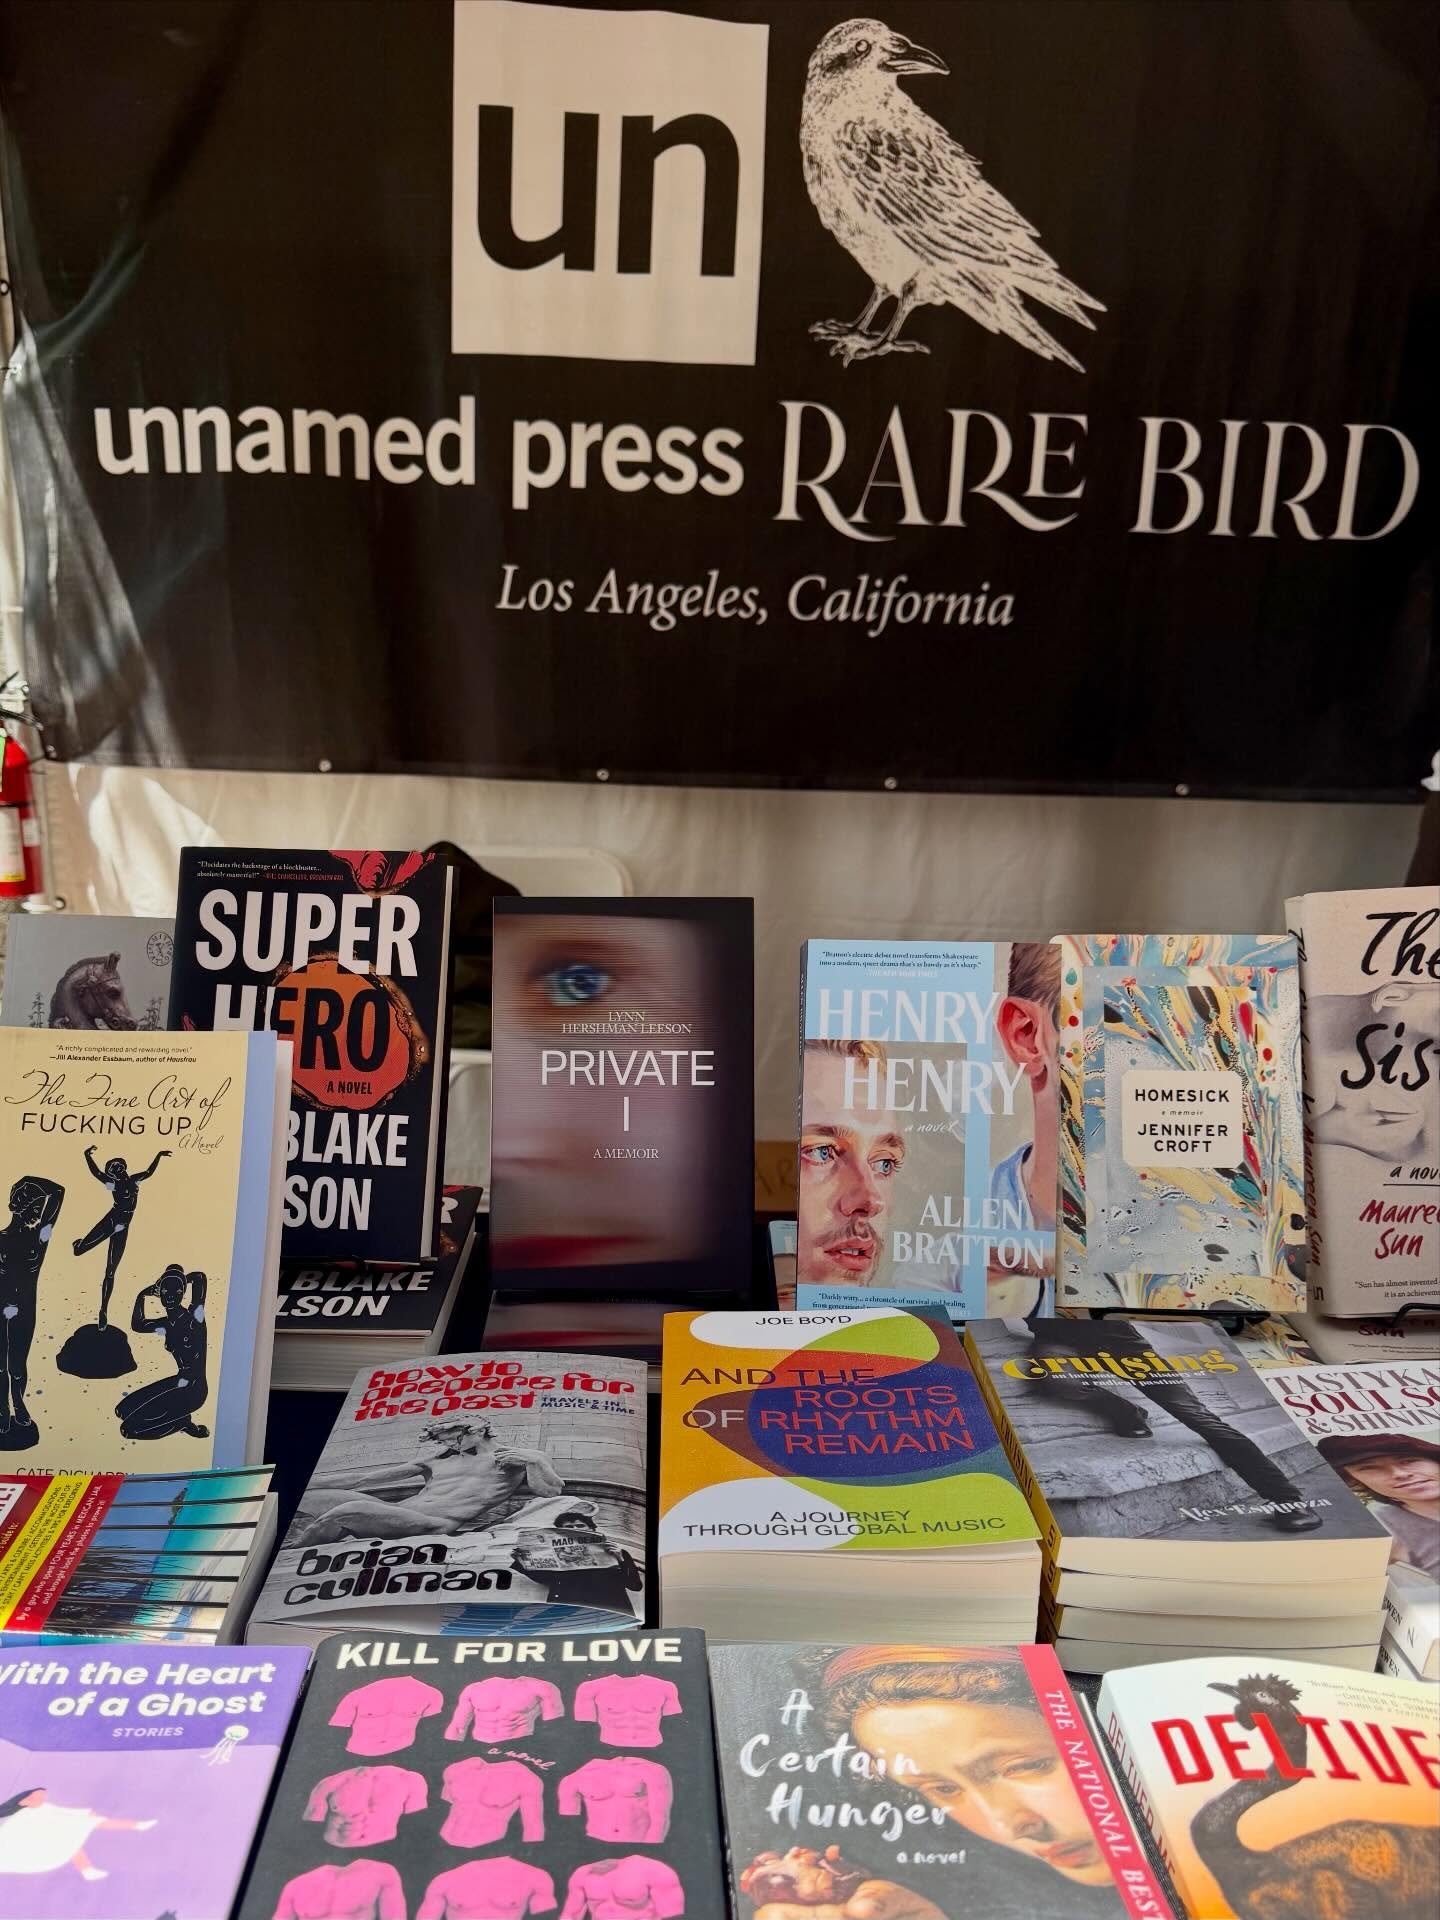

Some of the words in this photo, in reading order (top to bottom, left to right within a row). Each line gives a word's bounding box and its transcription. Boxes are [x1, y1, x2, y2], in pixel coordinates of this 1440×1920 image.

[478, 105, 739, 276] un
[94, 396, 475, 485] unnamed
[513, 420, 743, 509] press
[776, 402, 1087, 541] RARE
[1133, 417, 1418, 540] BIRD
[496, 565, 574, 612] Los
[586, 570, 767, 630] Angeles,
[789, 575, 1013, 637] California
[195, 888, 421, 977] SUPER
[213, 983, 391, 1072] HERO
[562, 1023, 637, 1034] HERSHMAN
[641, 1023, 692, 1034] LEESON
[608, 1011, 645, 1022] LYNN
[819, 988, 1000, 1044] HENRY
[65, 1045, 83, 1054] richly
[84, 1046, 124, 1054] complicated
[139, 1047, 170, 1055] rewarding
[67, 1054, 101, 1062] Alexander
[103, 1055, 135, 1063] Essbaum,
[1341, 1022, 1440, 1091] Sis
[541, 1050, 715, 1086] PRIVATE
[326, 1081, 334, 1093] A
[338, 1081, 372, 1095] NOVEL
[842, 1056, 1028, 1115] HENRY
[1135, 1089, 1229, 1102] HOMESICK
[5, 1069, 68, 1106] The
[69, 1073, 140, 1108] Fine
[148, 1075, 198, 1111] Art
[199, 1076, 232, 1131] of
[21, 1112, 146, 1135] FUCKING
[157, 1116, 192, 1135] UP
[624, 1096, 630, 1131] I
[287, 1110, 409, 1166] BLAKE
[916, 1120, 966, 1144] novel
[1137, 1124, 1228, 1136] JENNIFER
[178, 1133, 192, 1149] A
[193, 1133, 224, 1154] Novel
[593, 1149, 602, 1159] A
[605, 1148, 659, 1159] MEMOIR
[1154, 1140, 1212, 1152] CROFT
[1389, 1165, 1402, 1178] a
[920, 1194, 1034, 1232] ALLEN
[1359, 1199, 1440, 1224] Maure
[892, 1231, 1044, 1270] BRATTON
[1309, 1230, 1323, 1267] Sun
[1374, 1227, 1424, 1259] Sun
[291, 1270, 434, 1291] BLAKE
[1409, 1278, 1437, 1286] invented
[819, 1293, 842, 1301] "Darkly
[943, 1300, 966, 1308] healing
[755, 1317, 796, 1326] JOE
[799, 1314, 852, 1325] BOYD
[368, 1364, 475, 1389] how
[480, 1360, 523, 1377] to
[680, 1367, 776, 1385] AND
[787, 1367, 879, 1387] THE
[1002, 1349, 1239, 1380] Cruising
[360, 1375, 556, 1406] prepare
[562, 1372, 635, 1394] for
[1265, 1368, 1440, 1394] TASTYKA
[355, 1398, 428, 1421] the
[431, 1391, 537, 1416] past
[541, 1396, 599, 1404] TRAVELS
[603, 1405, 635, 1414] TIME
[795, 1385, 958, 1409] ROOTS
[1284, 1389, 1405, 1417] SOUL
[681, 1409, 744, 1429] OF
[760, 1407, 966, 1431] RHYTHM
[1305, 1417, 1332, 1434] &
[785, 1429, 975, 1455] REMAIN
[1001, 1414, 1033, 1499] CRUISING
[76, 1497, 95, 1523] MEXICAN
[770, 1511, 786, 1522] A
[793, 1510, 911, 1522] JOURNEY
[1178, 1507, 1228, 1522] Alex
[1229, 1499, 1333, 1514] Espinoza
[61, 1531, 76, 1548] YEARS
[682, 1524, 808, 1537] THROUGH
[814, 1523, 916, 1536] GLOBAL
[922, 1517, 1006, 1533] MUSIC
[40, 1592, 53, 1604] and
[48, 1570, 67, 1591] brought
[61, 1556, 74, 1568] back
[69, 1547, 79, 1555] the
[75, 1528, 92, 1546] photos
[51, 1549, 65, 1564] FOUR
[296, 1540, 448, 1578] brian
[33, 1580, 46, 1592] who
[283, 1565, 513, 1605] cullman
[28, 1594, 40, 1605] guy
[336, 1641, 440, 1670] KILL
[454, 1641, 546, 1664] FOR
[561, 1638, 683, 1664] LOVE
[79, 1661, 149, 1685] the
[155, 1662, 277, 1685] Heart
[48, 1691, 98, 1716] of
[99, 1697, 131, 1716] a
[137, 1691, 267, 1716] Ghost
[777, 1688, 814, 1735] A
[112, 1727, 184, 1738] STORIES
[487, 1747, 502, 1755] a
[504, 1750, 557, 1771] novel
[739, 1733, 920, 1779] Certain
[1151, 1711, 1440, 1790] DELIVE
[1045, 1690, 1078, 1730] THE
[1065, 1740, 1132, 1858] NATIONAL
[765, 1782, 955, 1842] Hunger
[896, 1852, 908, 1863] a
[913, 1849, 966, 1865] novel
